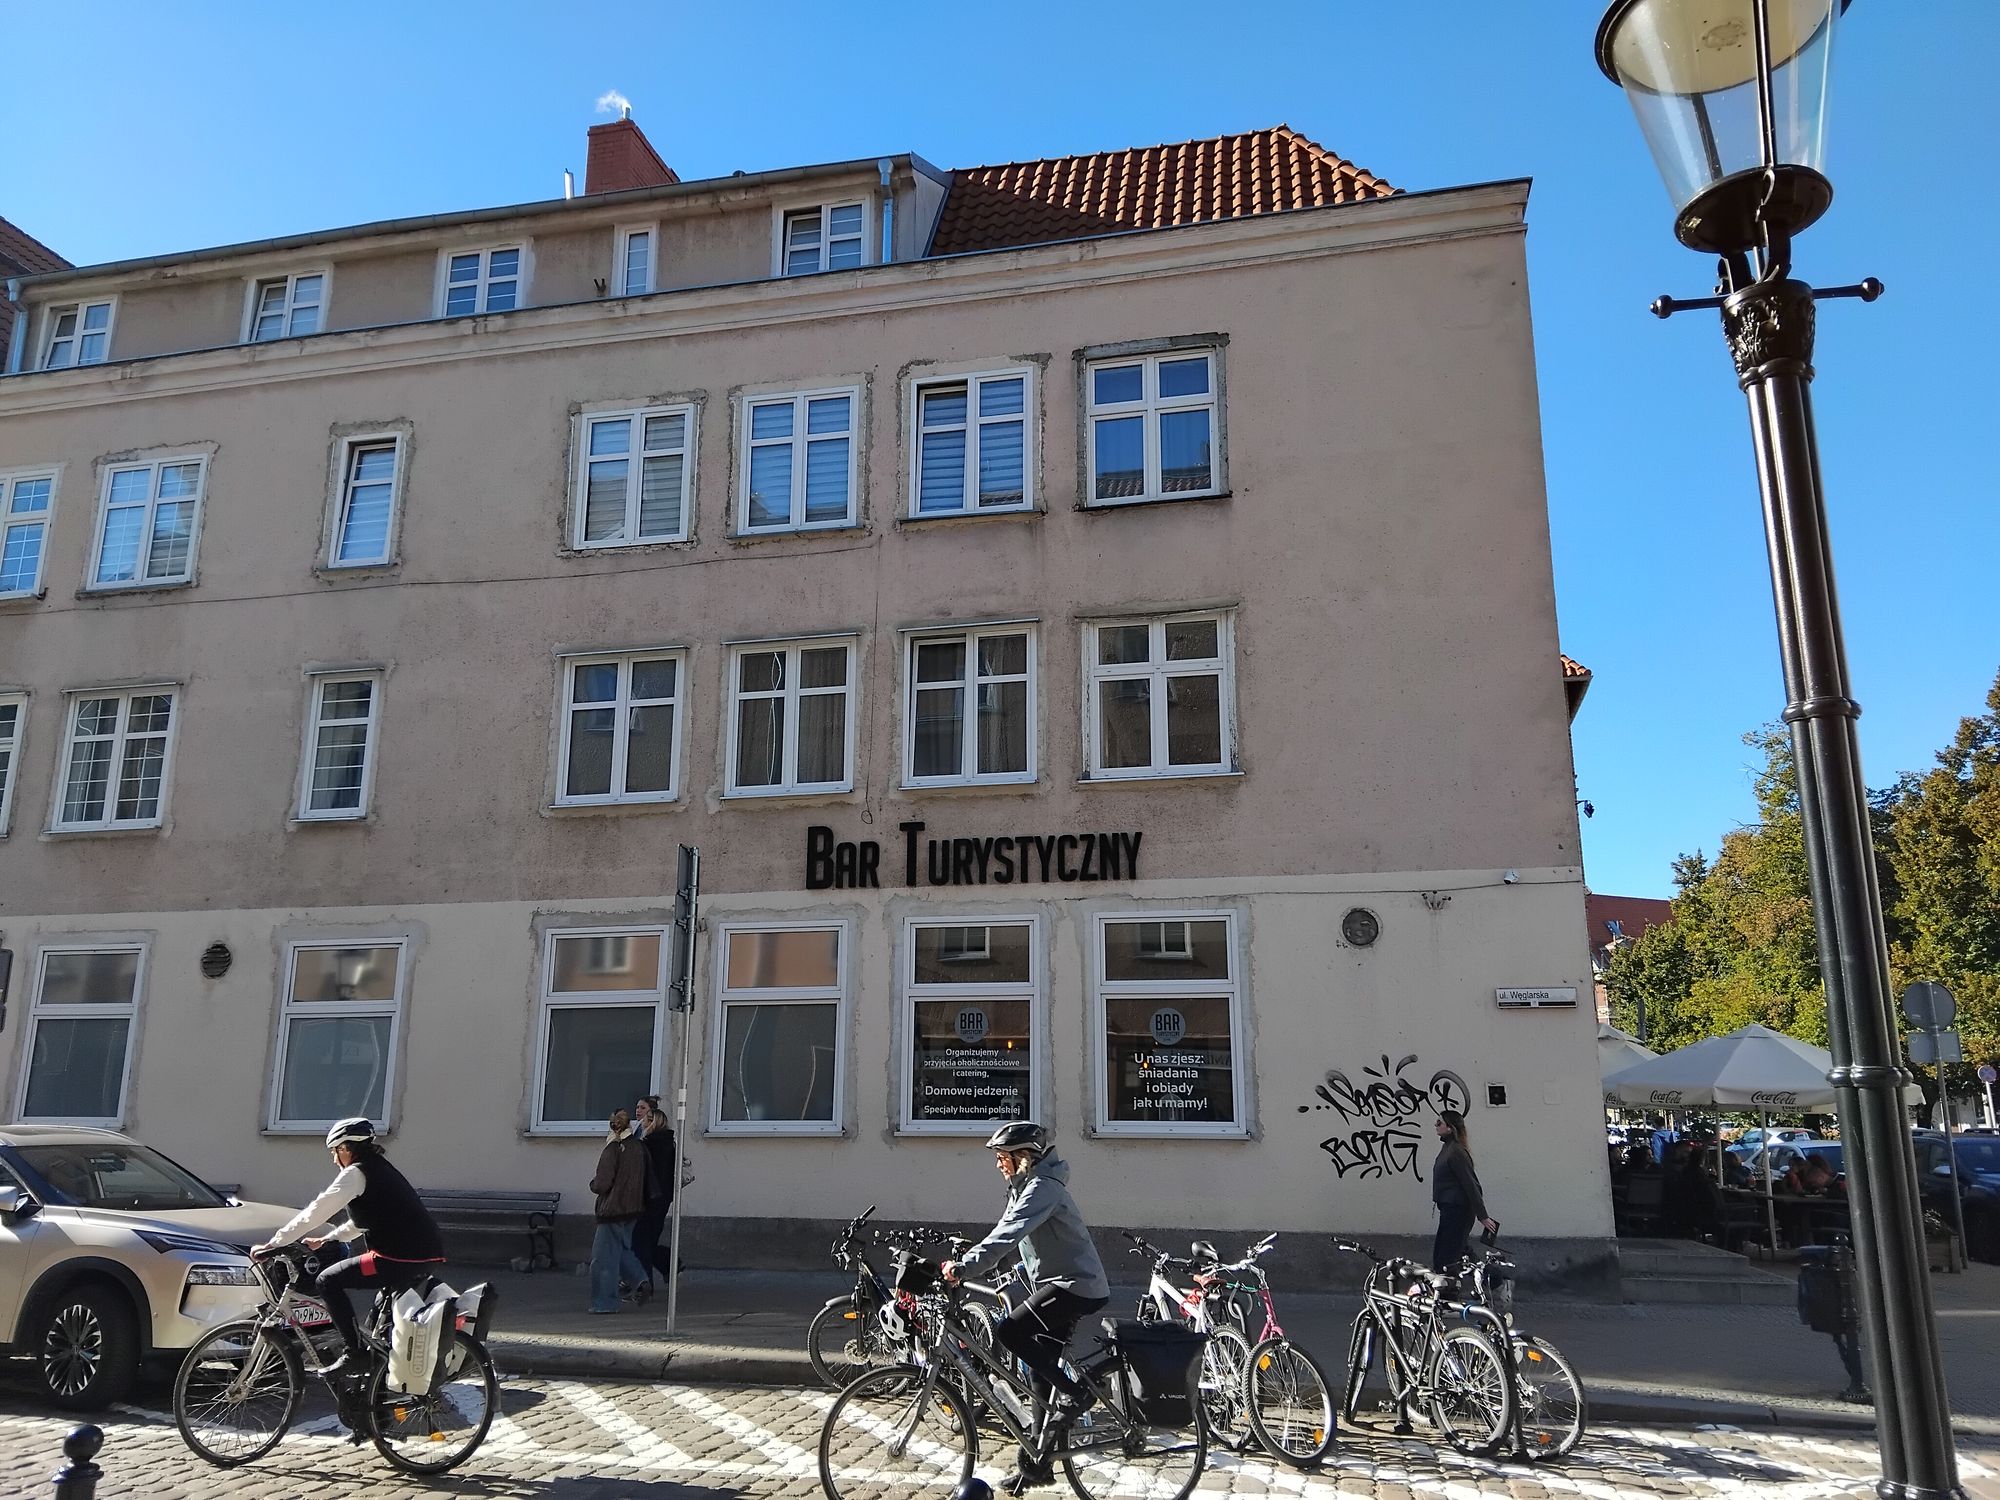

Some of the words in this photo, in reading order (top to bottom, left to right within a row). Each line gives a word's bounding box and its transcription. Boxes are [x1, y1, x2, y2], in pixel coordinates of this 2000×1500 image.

[1499, 991, 1508, 999] ul.
[1510, 991, 1549, 1000] Węglarska
[960, 1013, 983, 1029] BAR
[1155, 1014, 1180, 1031] BAR
[945, 1048, 999, 1057] Organizujemy
[924, 1059, 956, 1068] przyjęcia
[957, 1058, 1020, 1067] okolicznościowe
[1134, 1053, 1144, 1064] U
[1146, 1056, 1169, 1064] nas
[1171, 1053, 1204, 1066] zjesz:
[952, 1069, 956, 1077] i
[1138, 1067, 1199, 1079] śniadania
[925, 1085, 972, 1096] Domowe
[973, 1085, 1018, 1098] jedzenie
[1146, 1082, 1150, 1093] i
[1152, 1082, 1194, 1096] obiady
[924, 1104, 958, 1115] Specjały
[959, 1104, 988, 1113] kuchni
[988, 1104, 1021, 1115] polskiej
[1133, 1097, 1153, 1111] jak
[1154, 1099, 1163, 1108] u
[1165, 1097, 1208, 1111] mamy!
